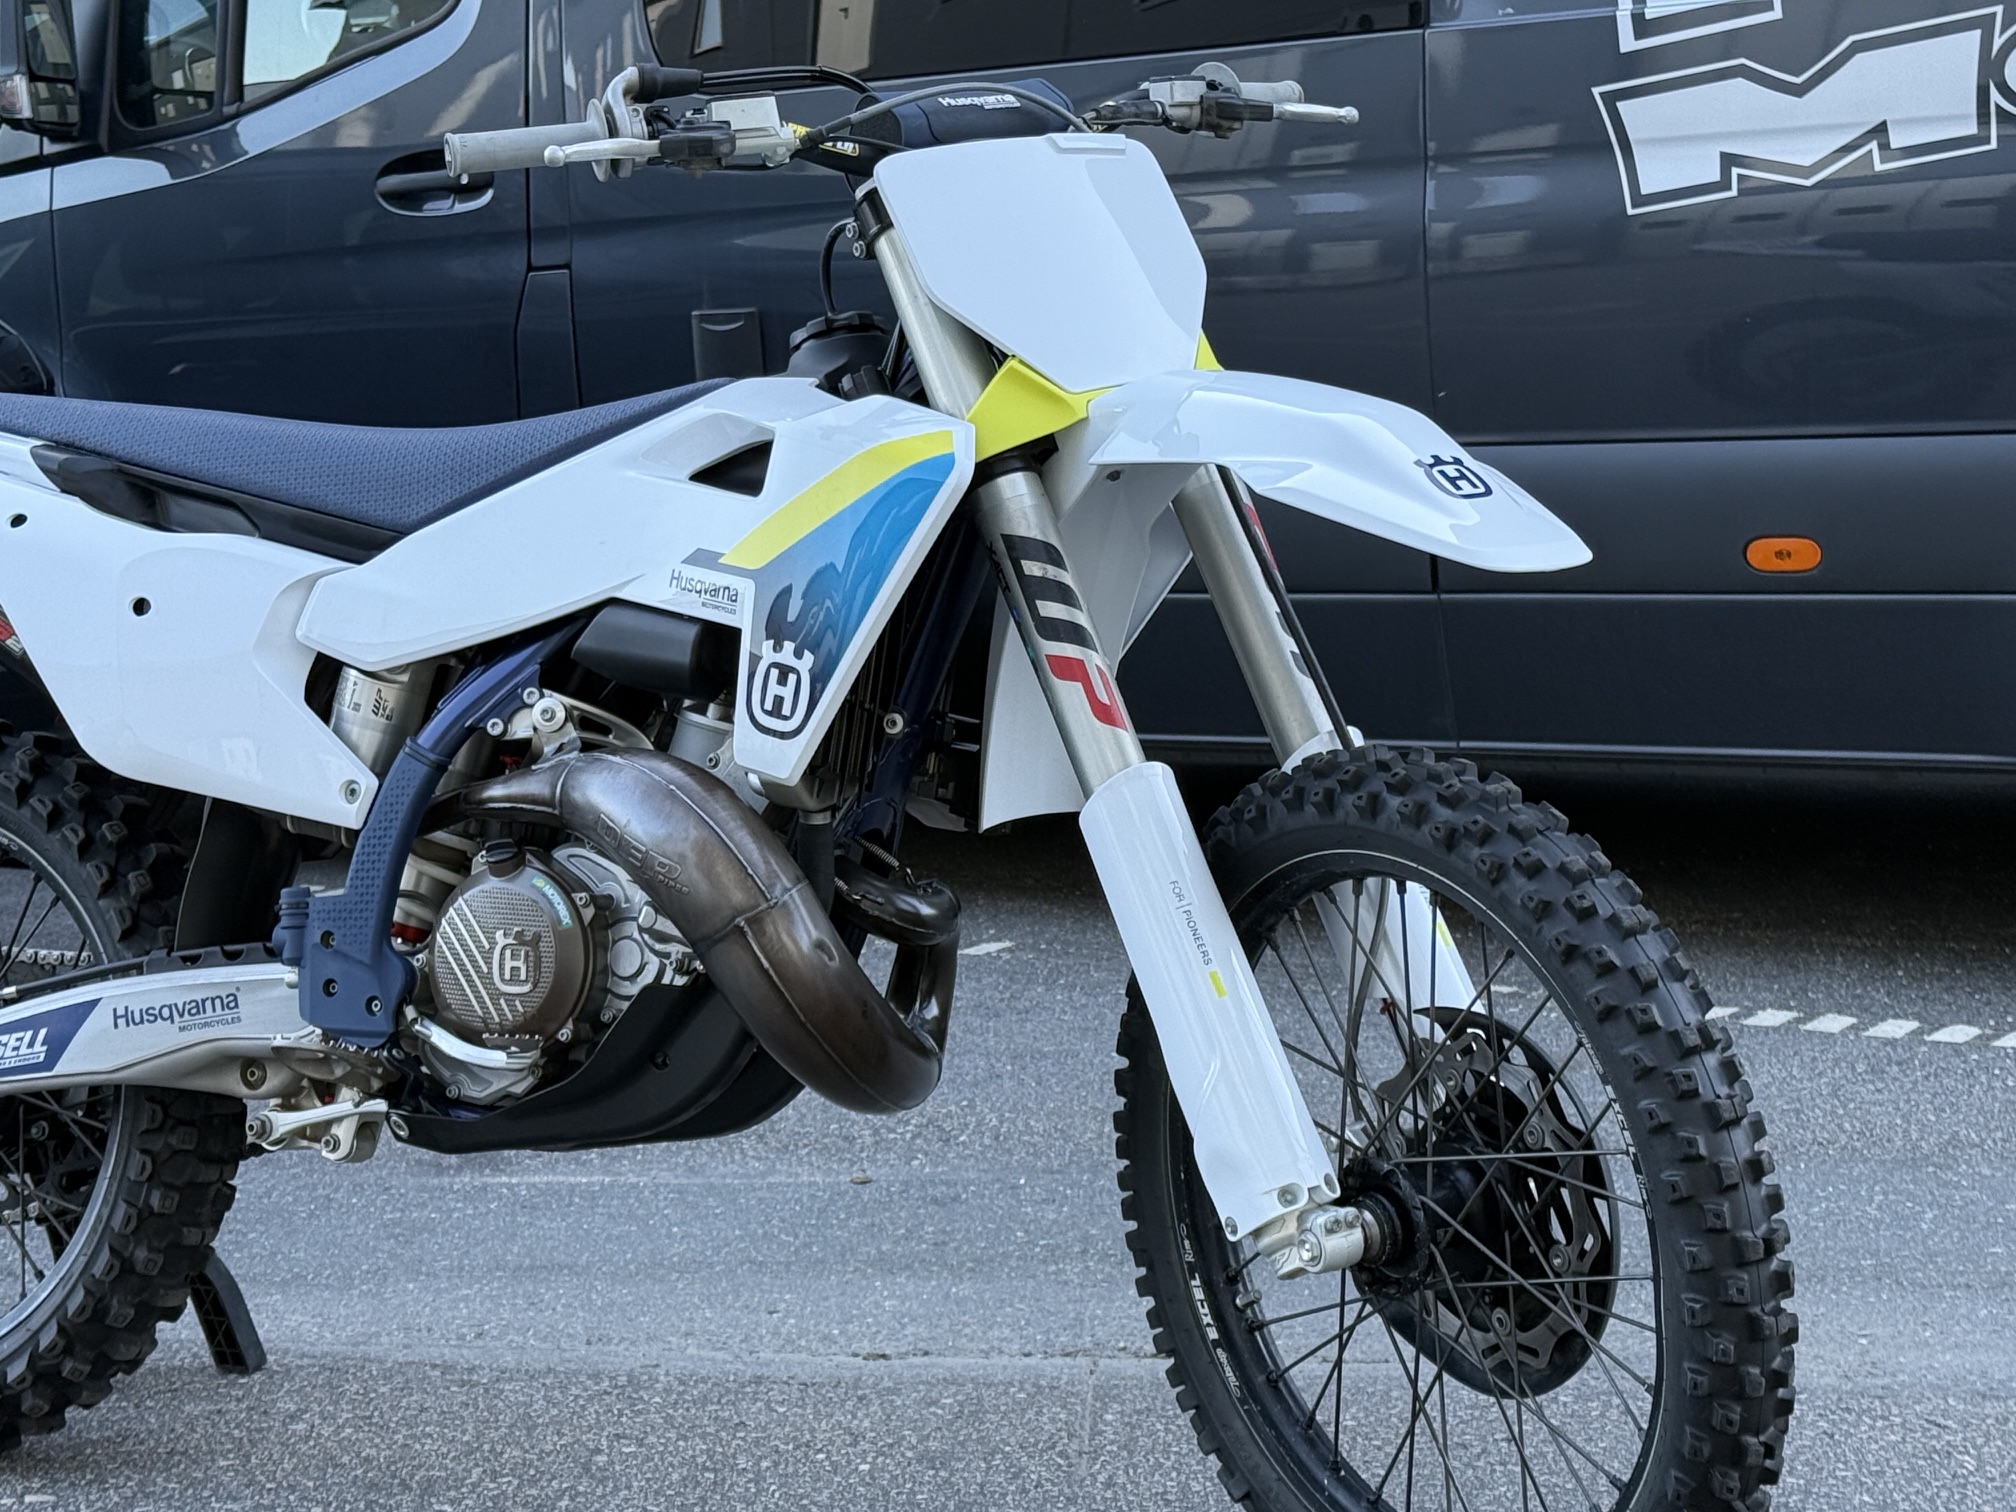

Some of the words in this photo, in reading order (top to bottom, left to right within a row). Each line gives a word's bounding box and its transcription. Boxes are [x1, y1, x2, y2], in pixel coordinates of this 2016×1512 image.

[669, 568, 739, 603] Husqvarna
[597, 813, 682, 880] DEP
[542, 884, 573, 926] MOTOREX
[1169, 880, 1186, 903] FOR
[1182, 908, 1213, 967] PIONEERS
[112, 993, 239, 1030] Husqvarna
[178, 1015, 242, 1033] MOTORCYCLES
[1191, 1272, 1220, 1341] EXCEL
